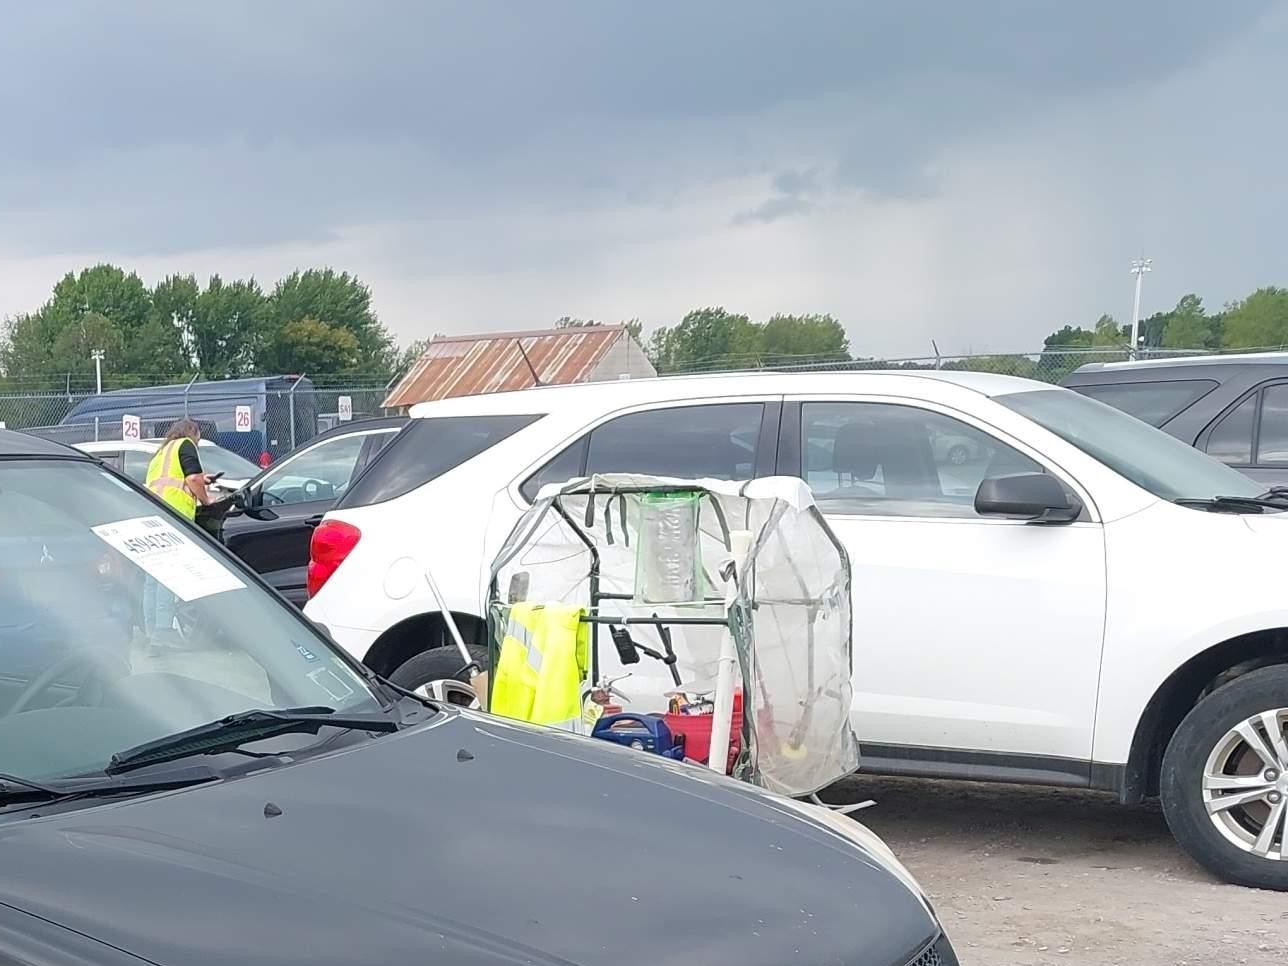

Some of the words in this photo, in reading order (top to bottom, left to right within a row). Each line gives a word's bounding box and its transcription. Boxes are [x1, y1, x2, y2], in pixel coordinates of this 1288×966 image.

[237, 412, 250, 427] 26
[124, 421, 138, 437] 25
[123, 531, 185, 554] 45942370
